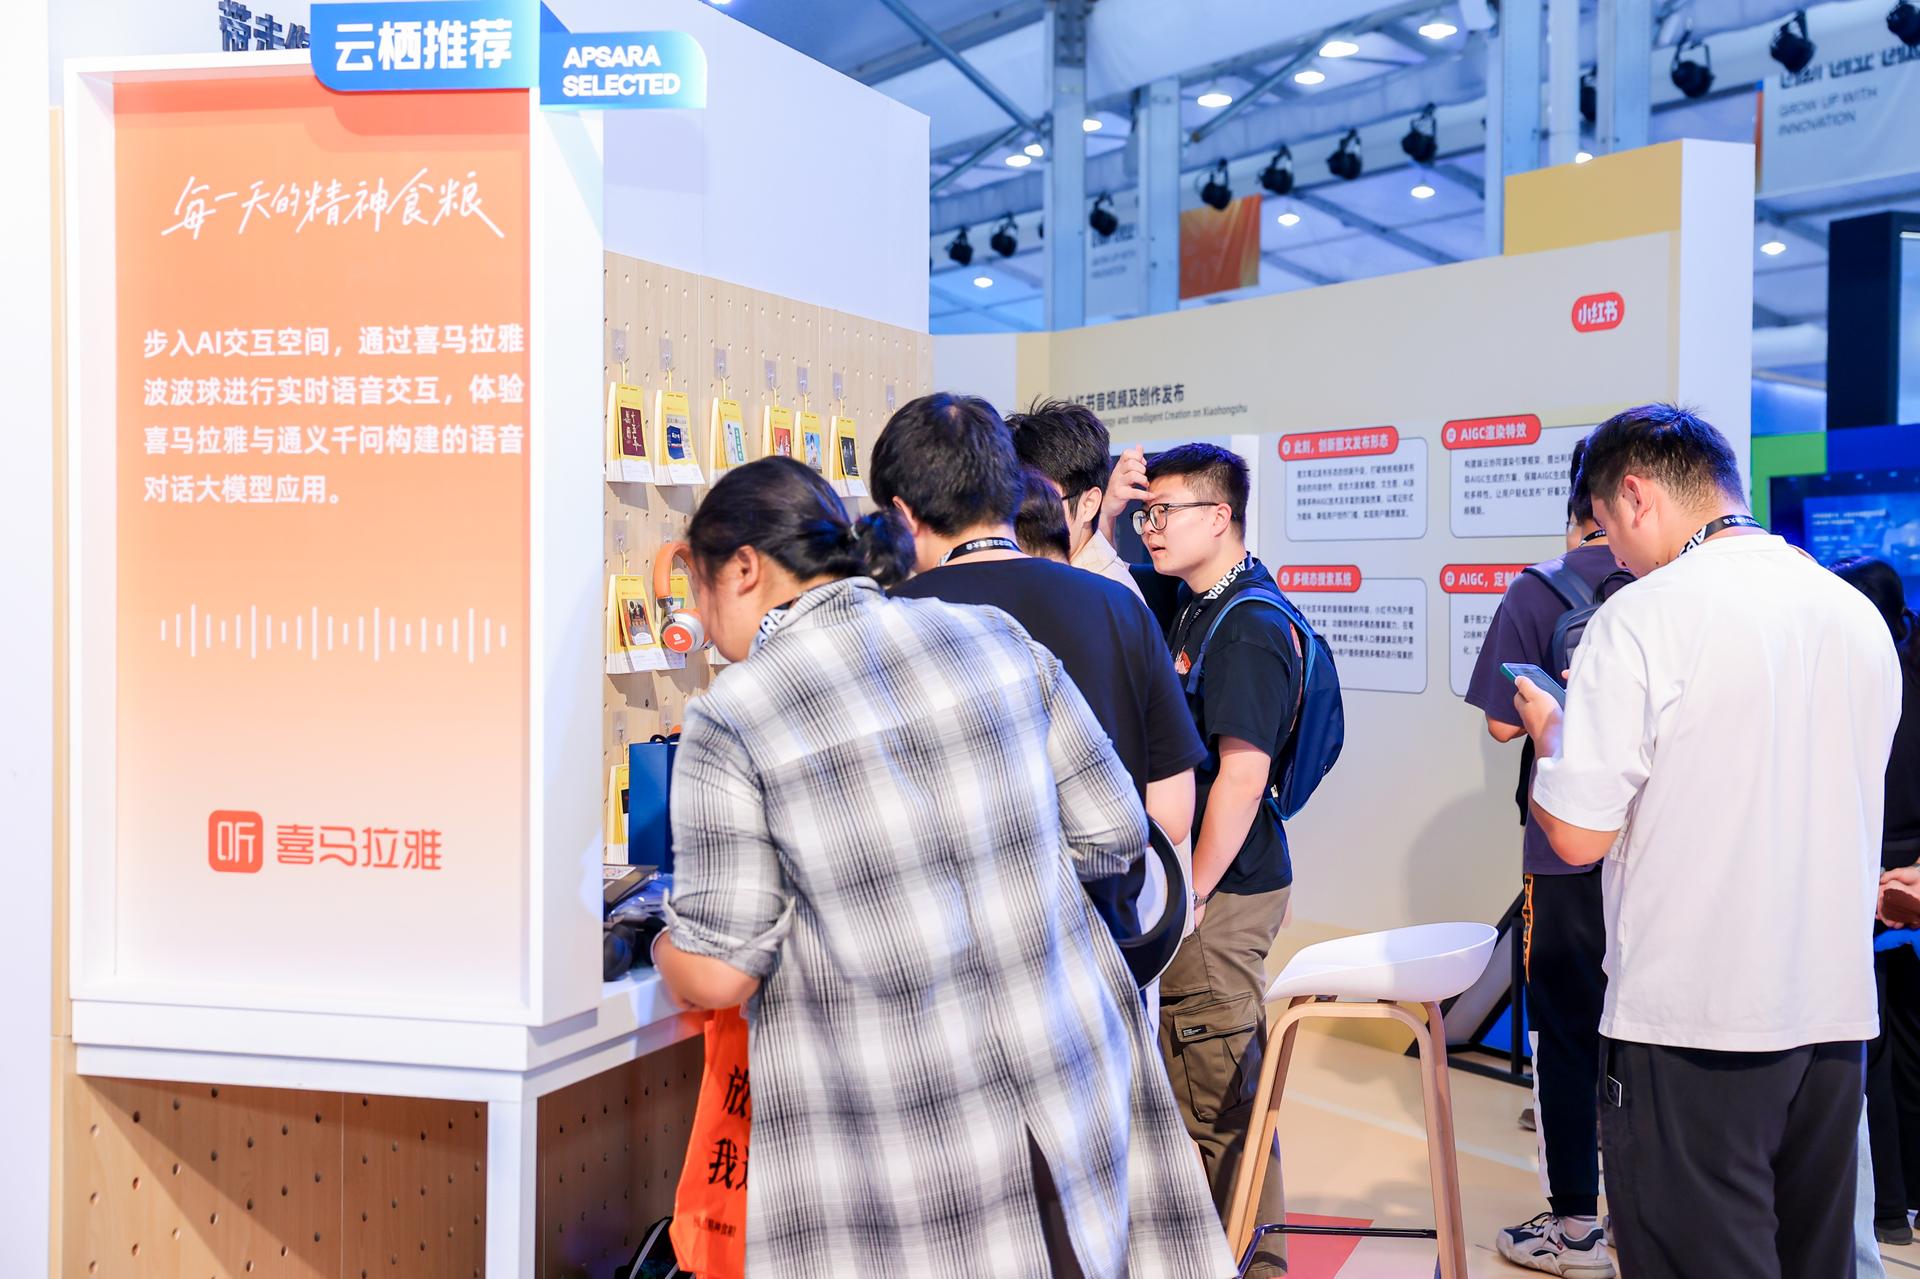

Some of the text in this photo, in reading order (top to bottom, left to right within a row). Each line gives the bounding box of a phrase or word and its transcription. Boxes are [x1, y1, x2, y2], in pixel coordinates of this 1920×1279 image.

[335, 19, 512, 71] 云栖推荐
[563, 45, 661, 68] APSARA
[562, 73, 681, 97] SELECTED
[161, 167, 505, 240] 每一天的精神食粮
[1578, 300, 1618, 325] 小红书
[143, 424, 525, 456] 喜马拉雅与通义千问构建的语音
[143, 473, 341, 505] 对话大模型应用。
[276, 824, 442, 870] 喜马拉雅
[722, 1064, 751, 1121] 放
